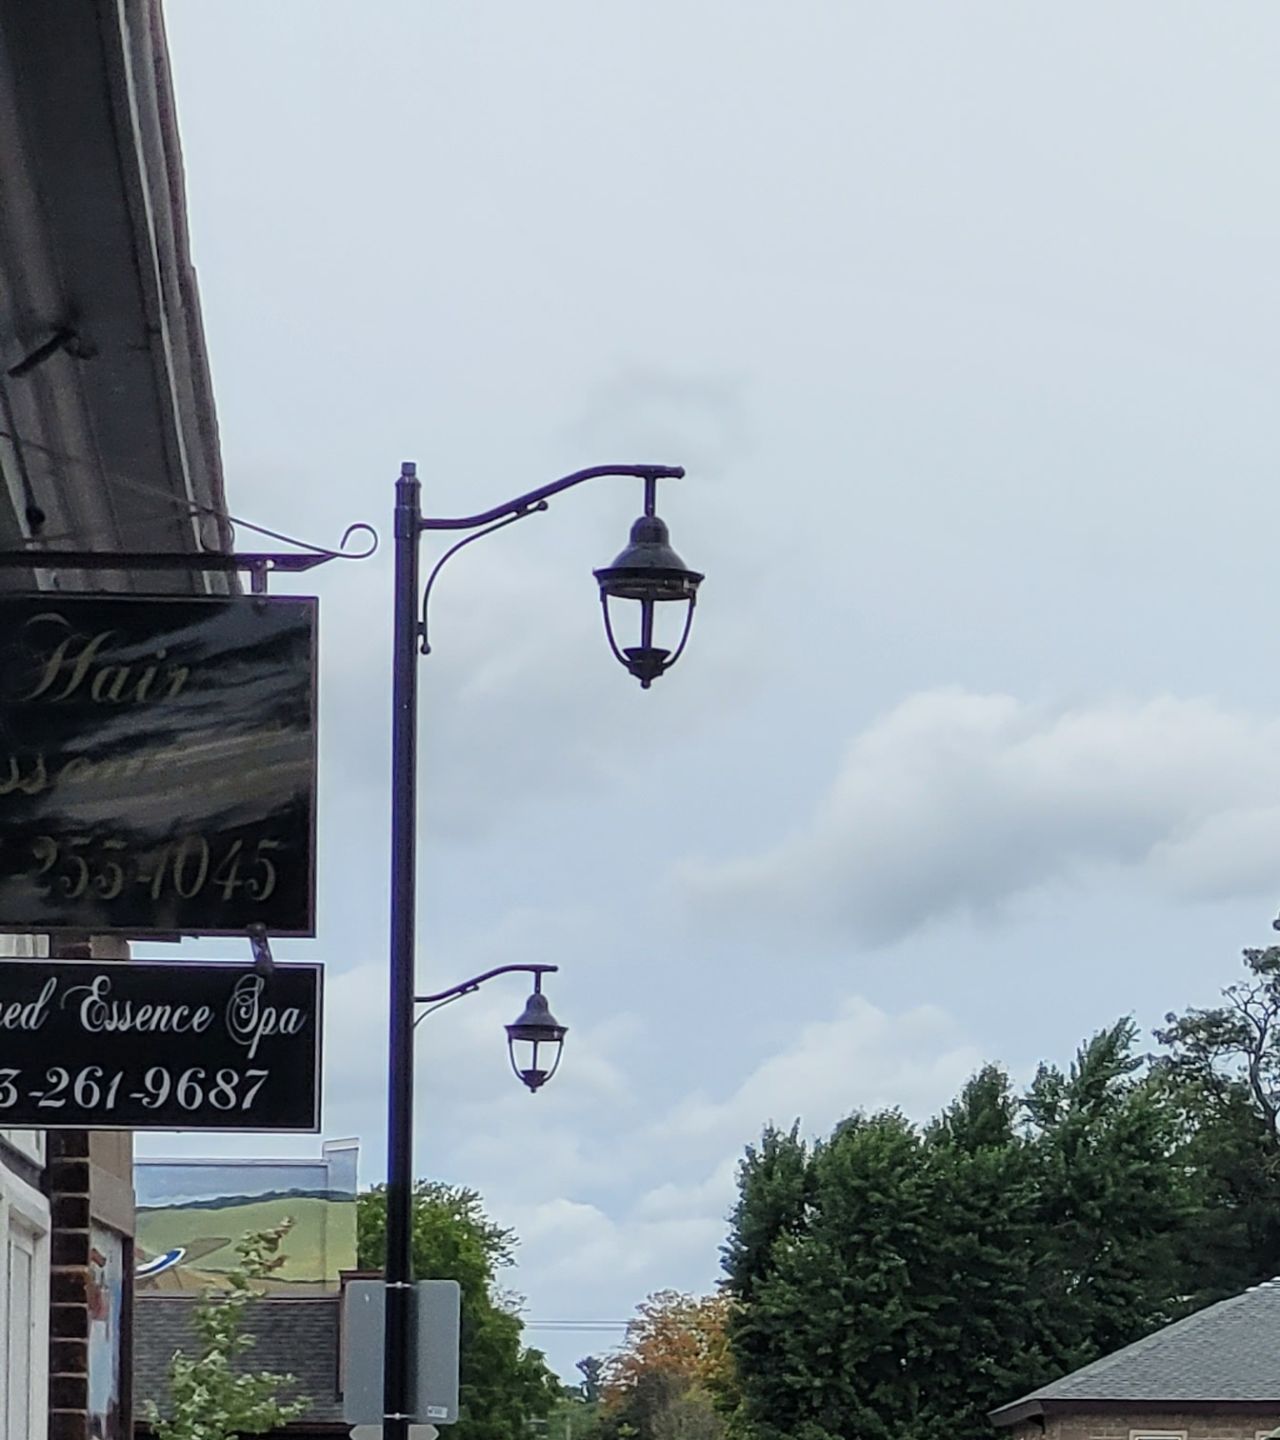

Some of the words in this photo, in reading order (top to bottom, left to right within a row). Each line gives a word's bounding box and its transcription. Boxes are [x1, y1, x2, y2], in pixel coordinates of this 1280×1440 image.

[24, 612, 190, 701] Hair
[0, 977, 57, 1030] ed
[61, 975, 214, 1032] Essence
[226, 974, 307, 1059] Spa
